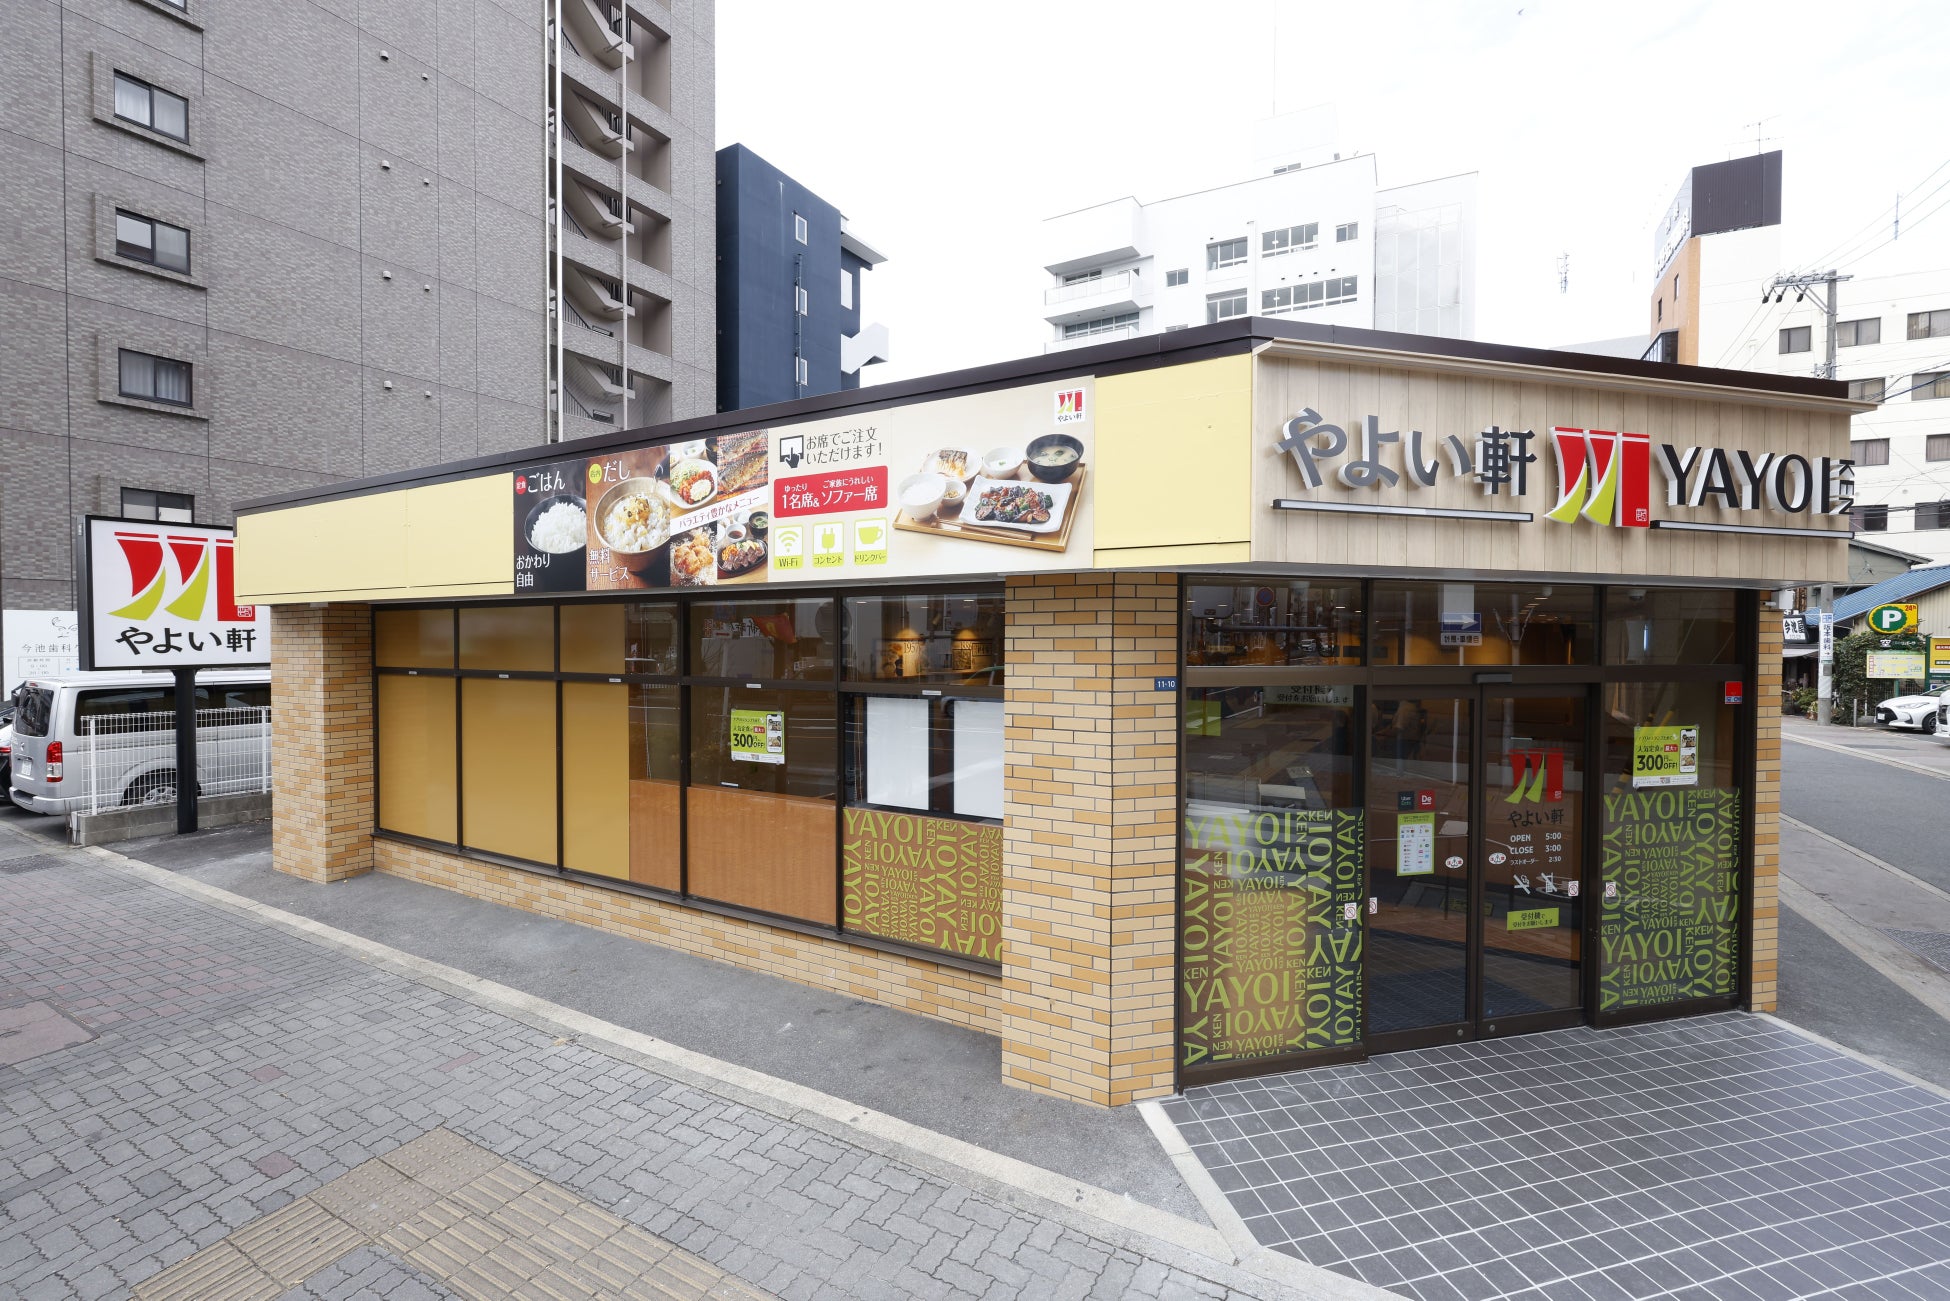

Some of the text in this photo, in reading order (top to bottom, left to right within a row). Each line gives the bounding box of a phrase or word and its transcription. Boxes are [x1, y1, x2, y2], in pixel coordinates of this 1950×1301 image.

[1058, 412, 1082, 422] やよい軒
[806, 427, 877, 450] お席でご注文
[1273, 407, 1537, 496] やよい軒
[603, 460, 630, 482] だし
[1656, 444, 1830, 514] YAYOI
[516, 480, 526, 490] 定食
[527, 471, 566, 493] ごはん
[784, 483, 808, 493] ゆったり
[823, 475, 874, 490] ご家族にうれしい
[1830, 459, 1855, 514] KEN
[679, 495, 760, 528] バラエティ豊かなメニュー
[516, 552, 551, 570] おかわり
[589, 548, 610, 565] 無料
[778, 556, 798, 567] Wi-Fi
[813, 555, 843, 564] コンセント
[853, 552, 886, 563] ドリンクバー
[516, 571, 534, 587] 自由
[589, 566, 629, 583] サービス
[1882, 610, 1902, 629] P
[115, 626, 257, 655] やよい軒
[733, 733, 753, 748] 300
[1637, 755, 1663, 771] 300
[1603, 790, 1684, 822] YAYOI
[1508, 808, 1564, 827] やよい軒
[843, 809, 923, 845] YAYOI
[1185, 811, 1291, 849] YAYOI
[1510, 832, 1561, 842] OPEN 5:00
[1510, 844, 1561, 855] CLOSE 3:00
[1602, 928, 1682, 964] YAYOI
[1184, 971, 1290, 1013] YAYOI
